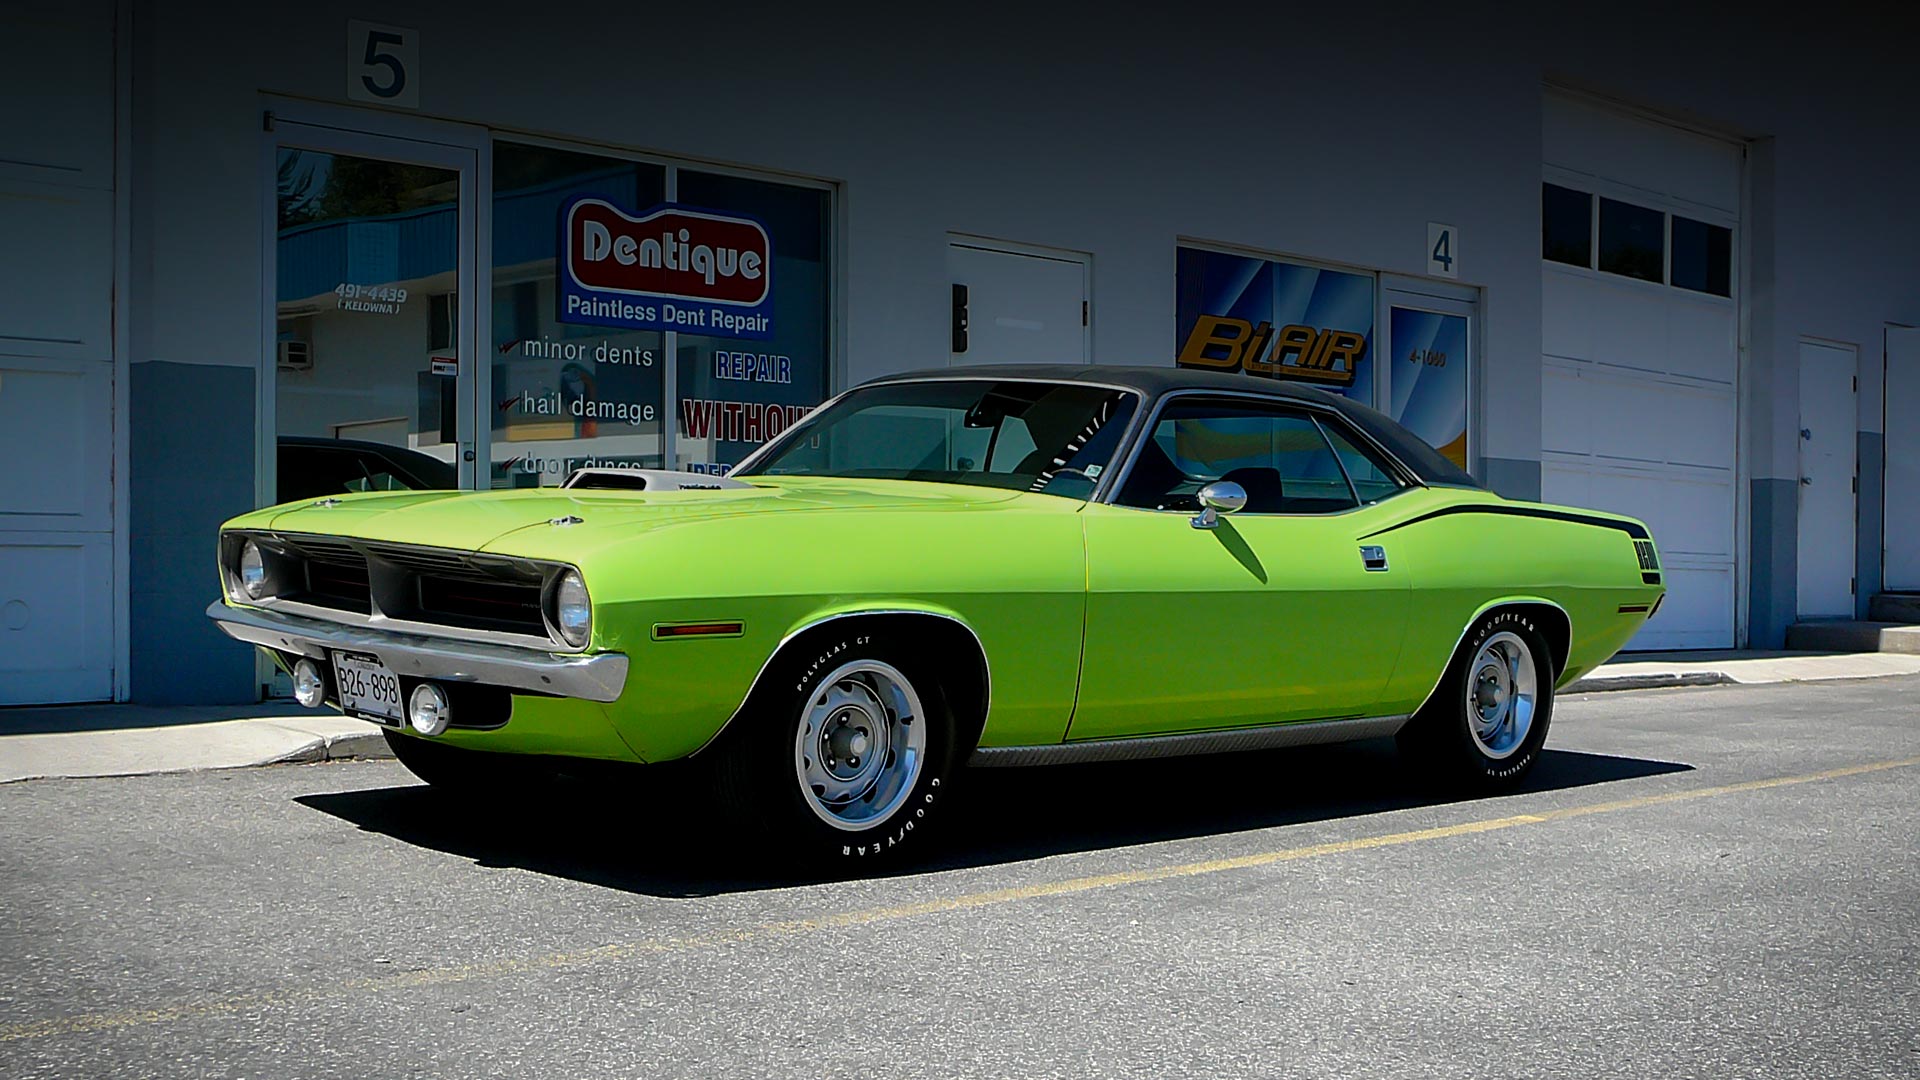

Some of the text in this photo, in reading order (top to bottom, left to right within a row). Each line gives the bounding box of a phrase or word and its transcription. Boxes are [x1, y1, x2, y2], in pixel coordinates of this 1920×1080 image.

[362, 30, 405, 98] 5
[583, 219, 763, 286] Dentique
[1432, 229, 1453, 272] 4
[334, 283, 408, 303] 491-4439
[567, 294, 769, 334] Paintless Dent Repair
[524, 335, 654, 367] minor dents
[715, 350, 792, 384] REPAIR
[523, 389, 655, 426] hail damage
[523, 452, 576, 474] door
[796, 635, 872, 692] POLYGLAS GT
[339, 667, 398, 704] B26-898
[842, 777, 941, 857] GOODYEAR
